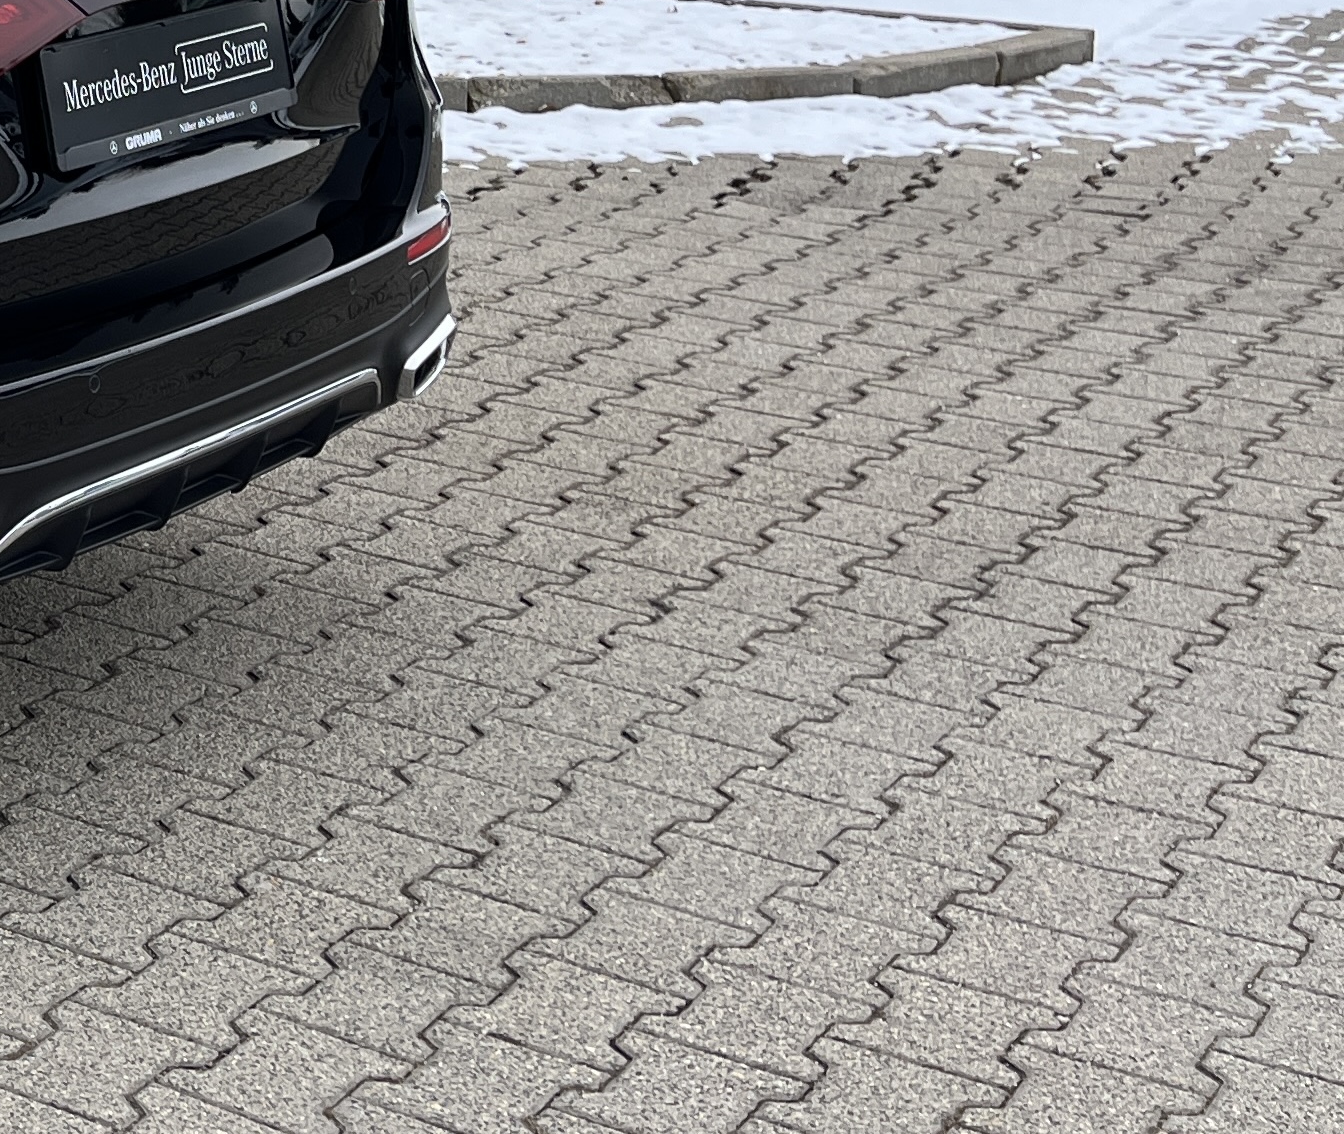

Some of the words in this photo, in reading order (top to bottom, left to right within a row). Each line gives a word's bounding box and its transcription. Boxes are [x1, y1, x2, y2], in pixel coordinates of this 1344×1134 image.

[63, 61, 178, 113] Mercedes-Benz
[180, 49, 222, 86] Junge
[222, 38, 269, 70] Sterne
[125, 128, 163, 151] GRUMA
